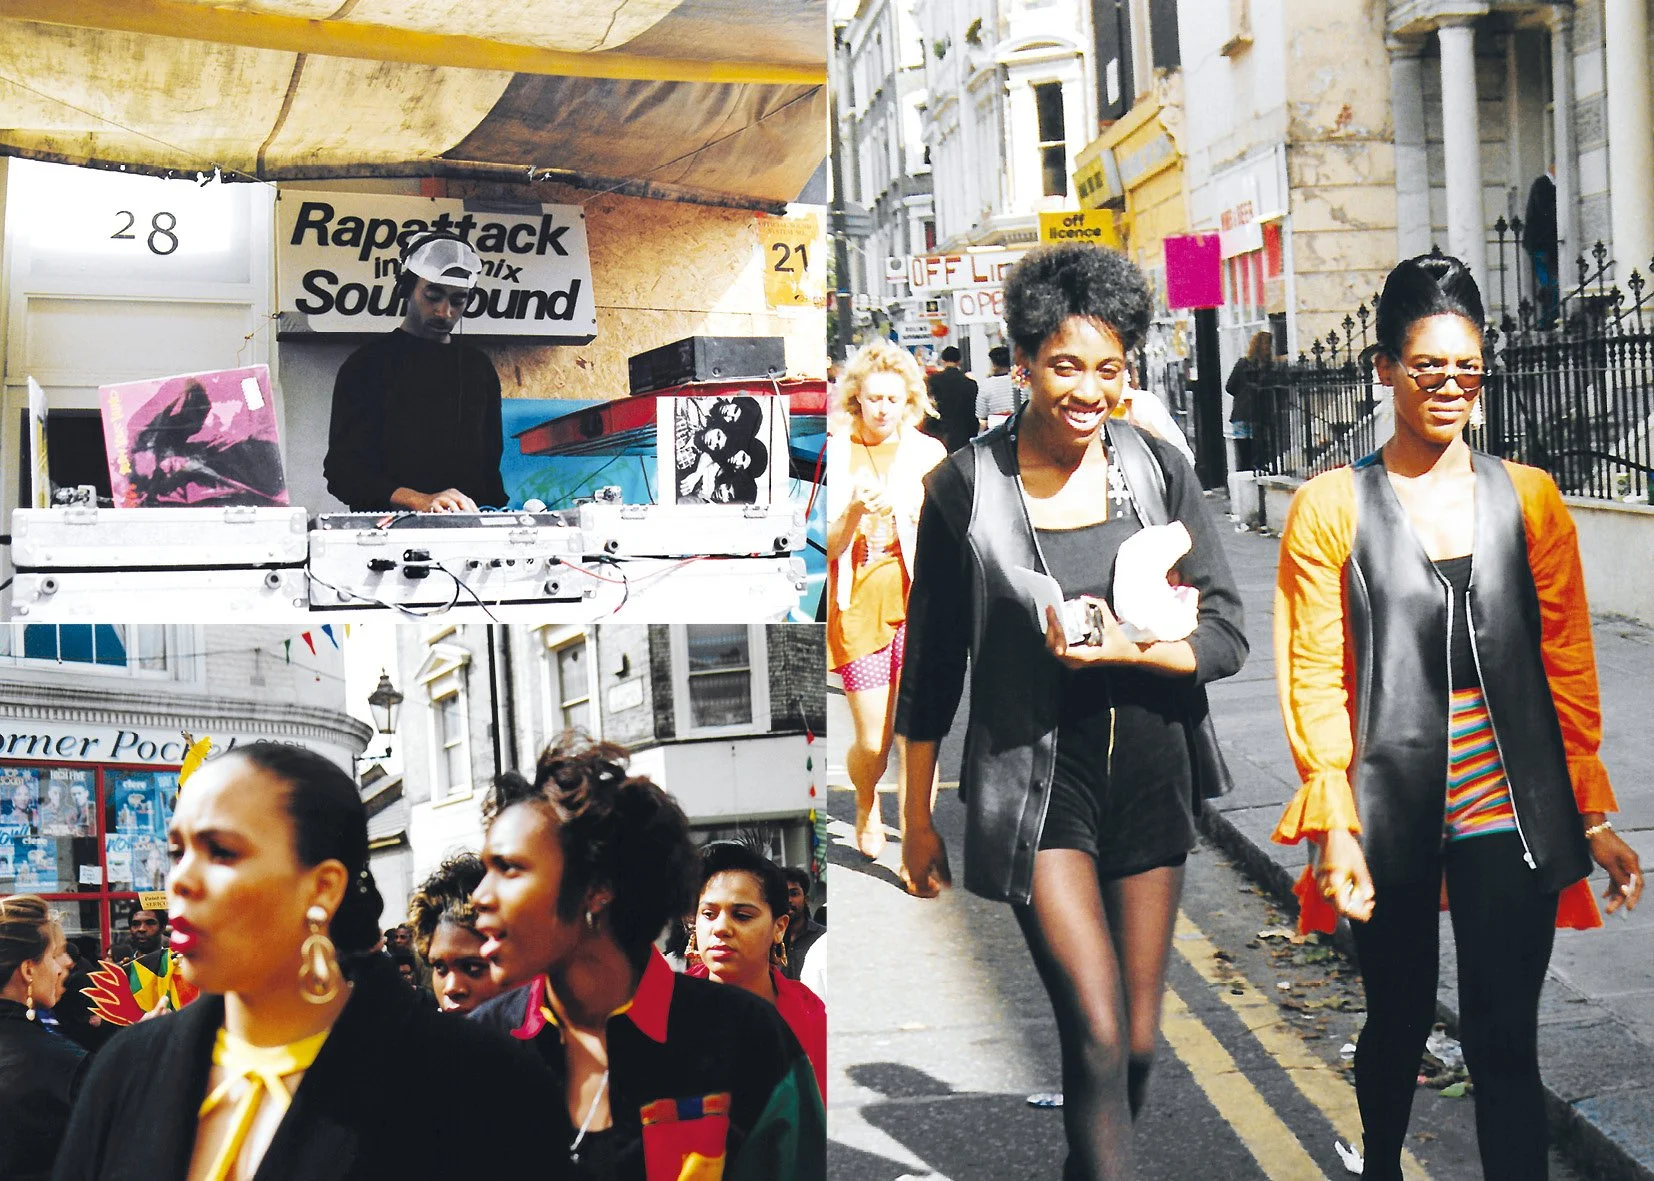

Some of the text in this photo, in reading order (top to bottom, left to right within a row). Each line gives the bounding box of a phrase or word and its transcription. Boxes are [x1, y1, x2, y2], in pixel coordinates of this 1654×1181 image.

[110, 210, 179, 256] 28
[290, 201, 570, 263] Rapattack
[1049, 227, 1102, 239] licence
[1063, 214, 1085, 227] off
[772, 242, 809, 273] 21
[912, 256, 961, 287] OFF
[461, 279, 582, 321] ound
[960, 290, 1004, 316] OPE
[0, 734, 99, 757] rner
